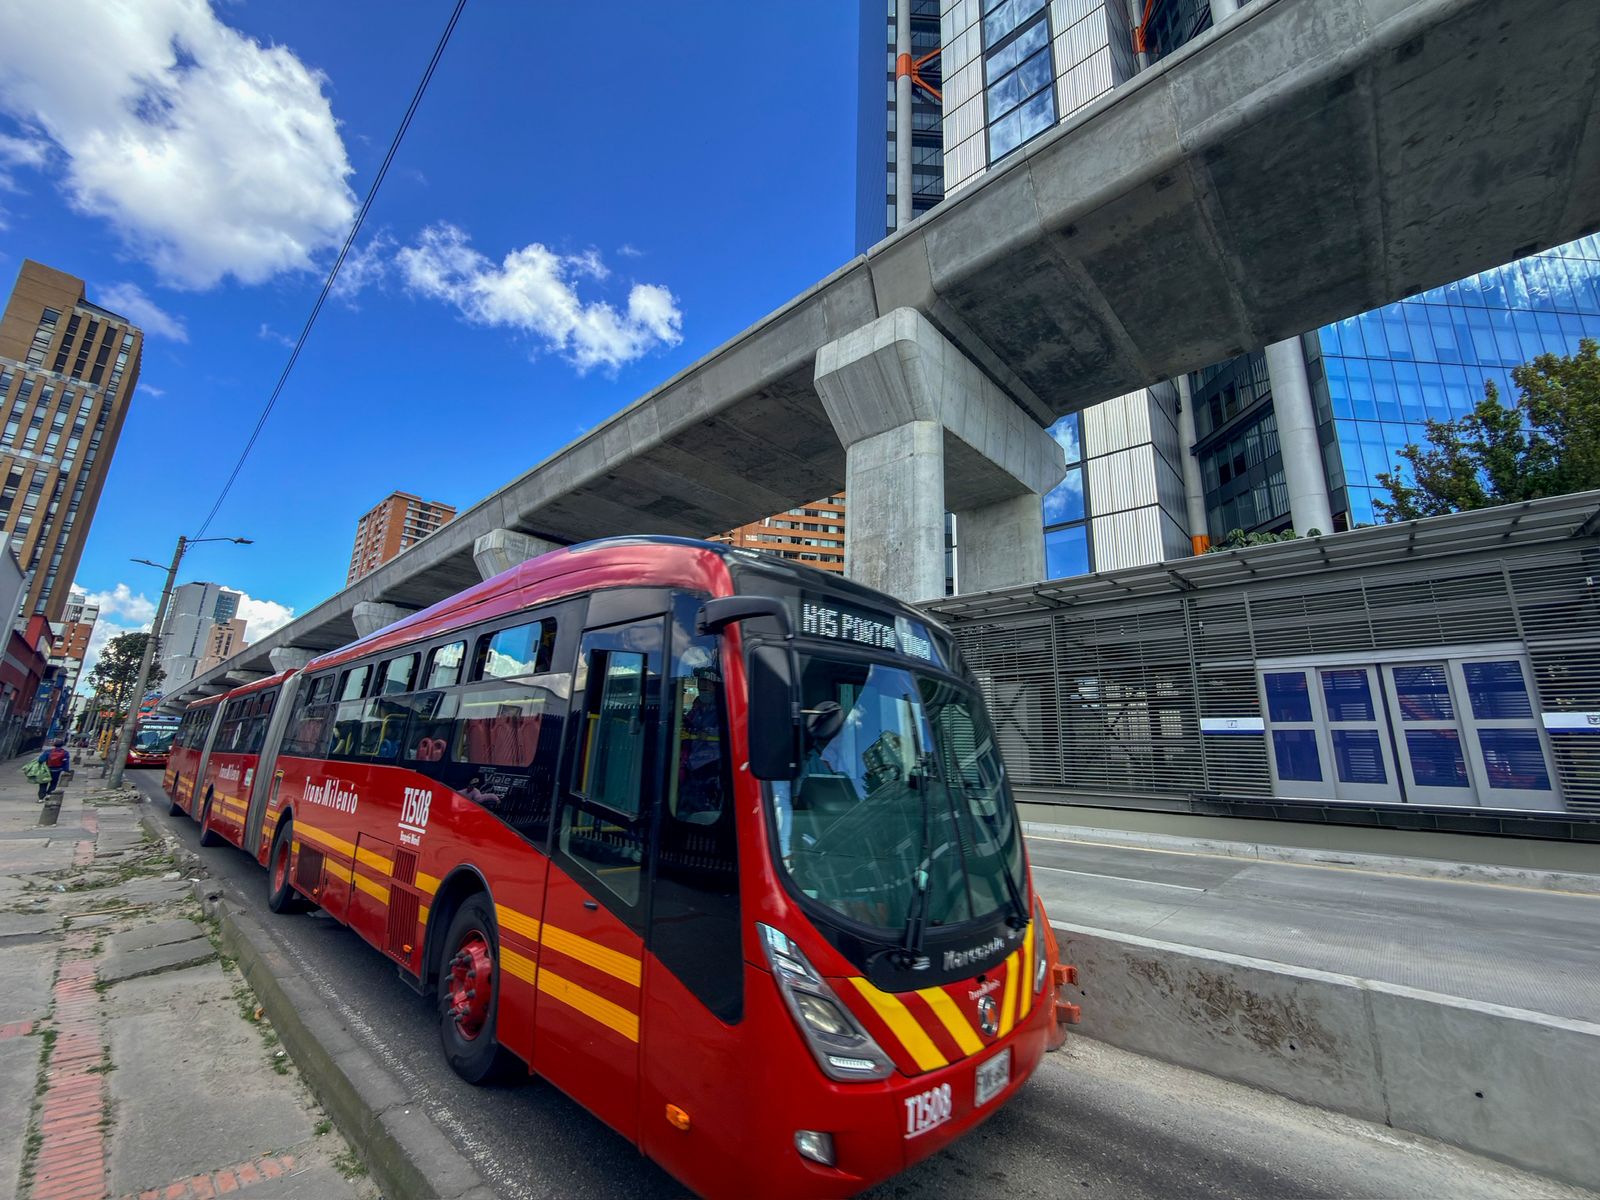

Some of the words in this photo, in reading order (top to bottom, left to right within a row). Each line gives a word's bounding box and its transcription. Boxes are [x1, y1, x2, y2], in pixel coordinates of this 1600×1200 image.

[803, 604, 838, 637] H15
[303, 776, 358, 814] TransMilenio
[401, 787, 432, 827] T1508
[904, 1082, 952, 1132] T1508
